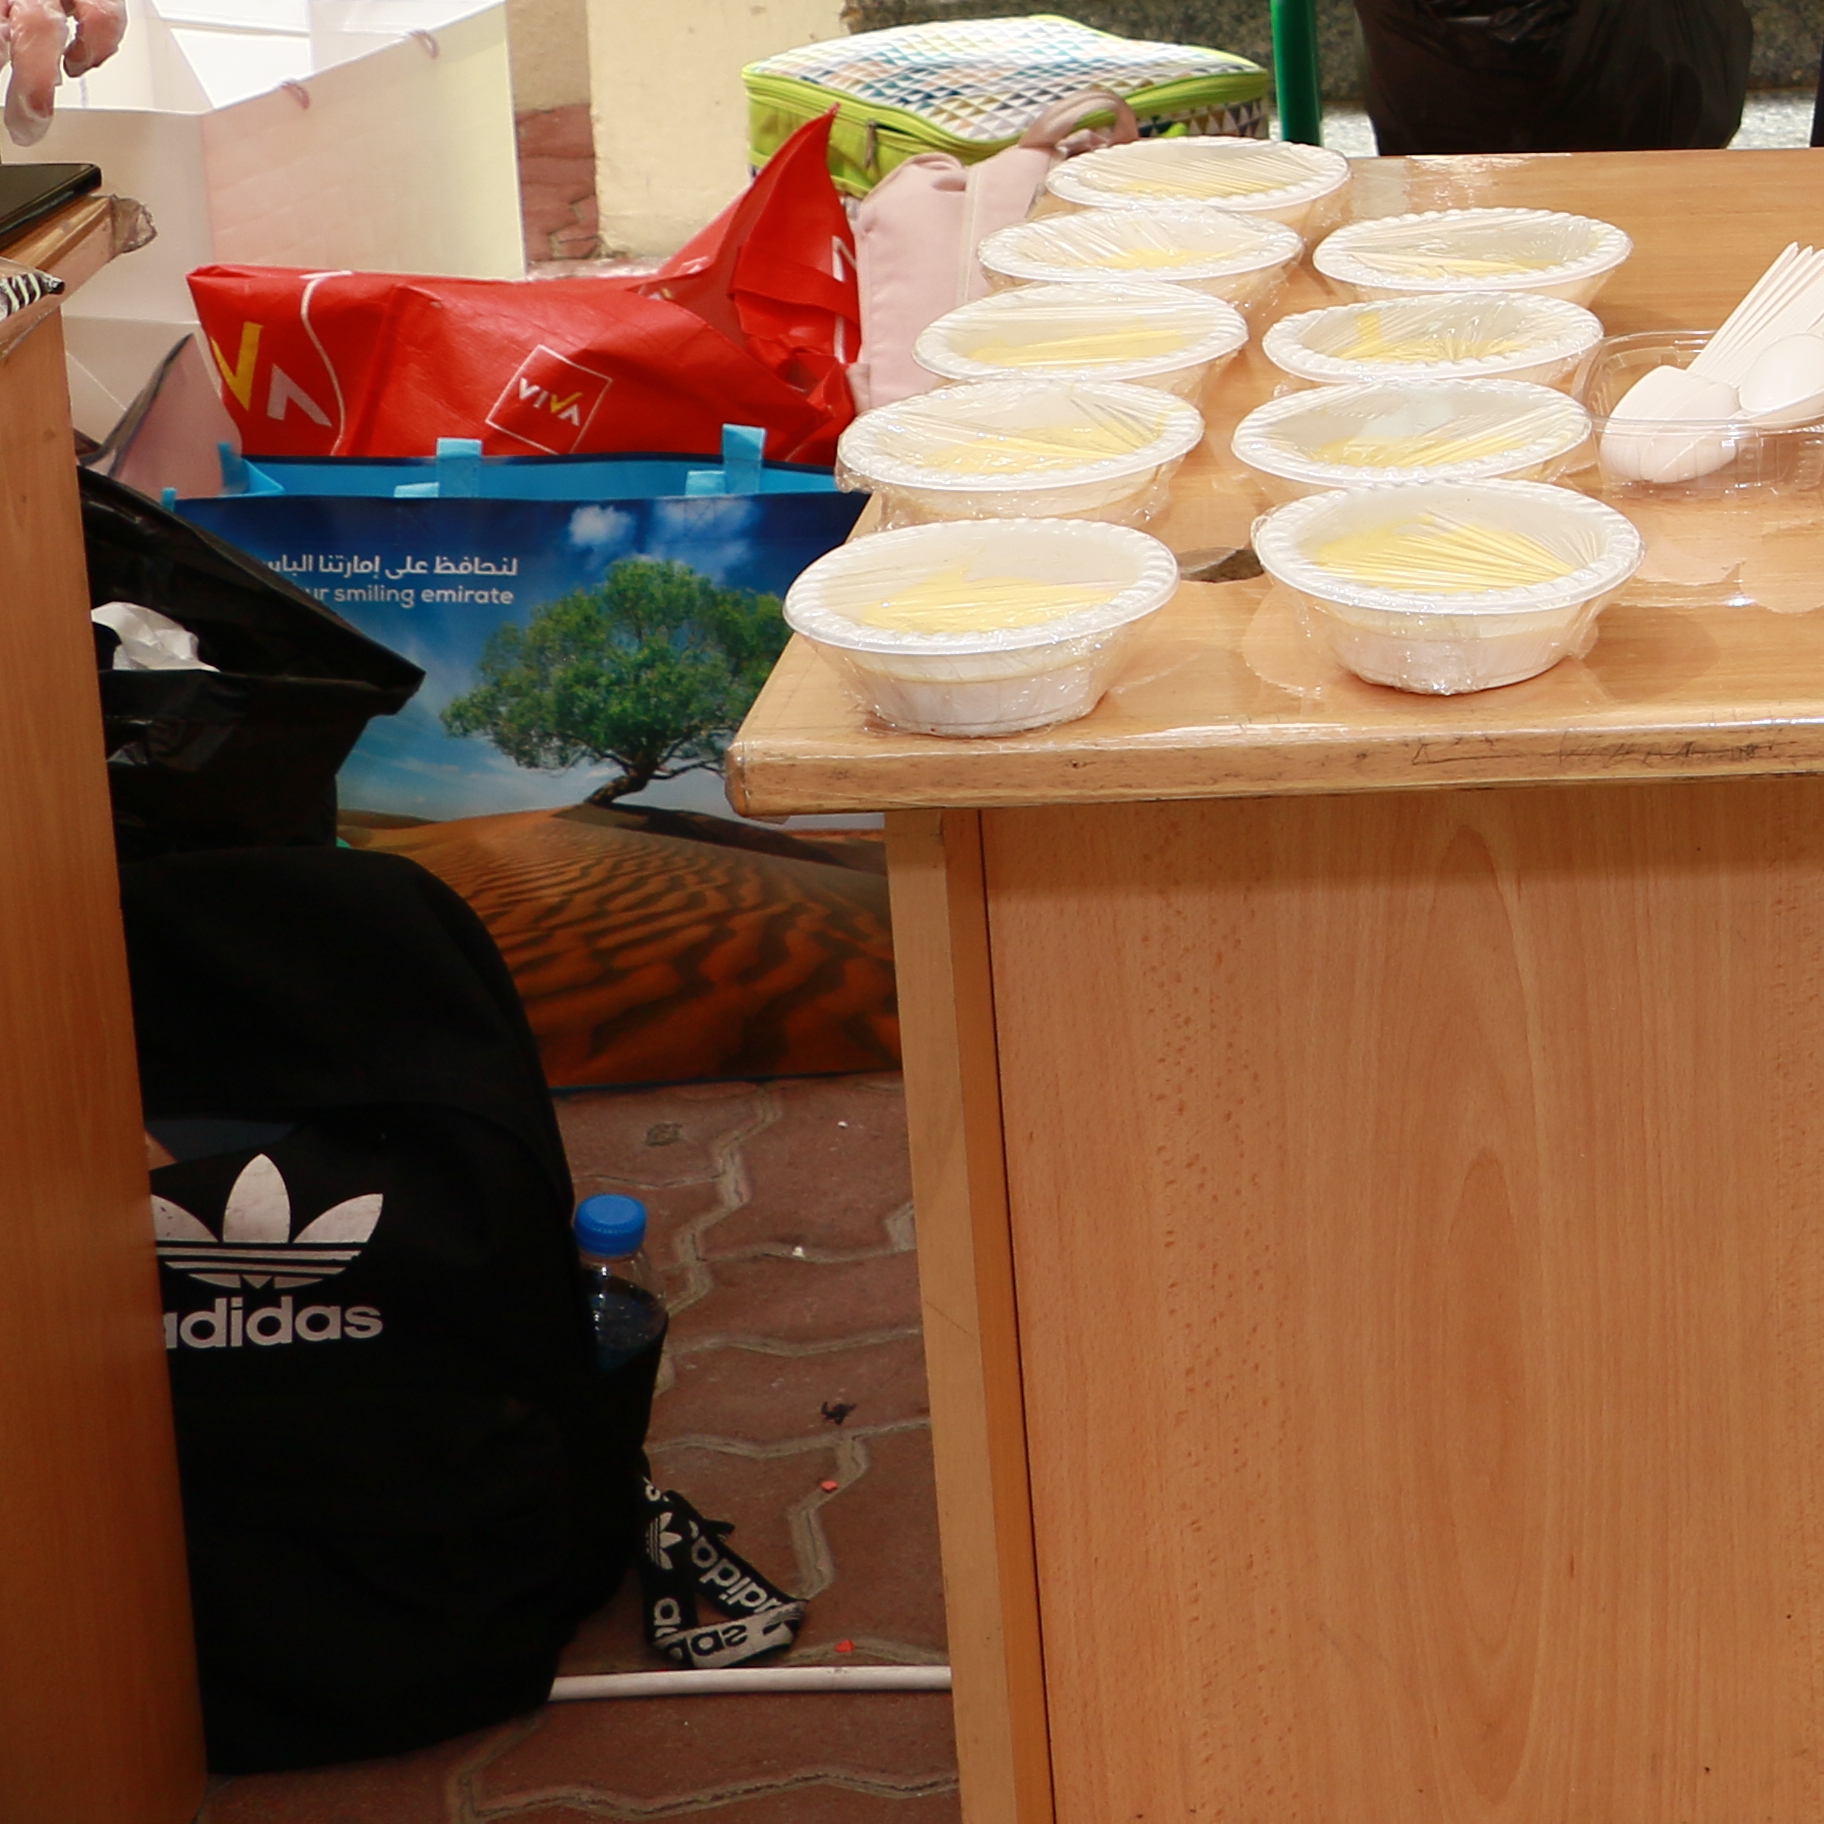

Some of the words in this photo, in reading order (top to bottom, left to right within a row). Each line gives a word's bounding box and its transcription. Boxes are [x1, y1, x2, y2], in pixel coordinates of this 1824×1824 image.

[519, 377, 582, 427] VIVA
[319, 555, 380, 579] إمارتنا
[385, 555, 428, 580] على
[434, 555, 518, 576] لنحافظ
[334, 584, 415, 608] smiling
[421, 585, 514, 605] emirate
